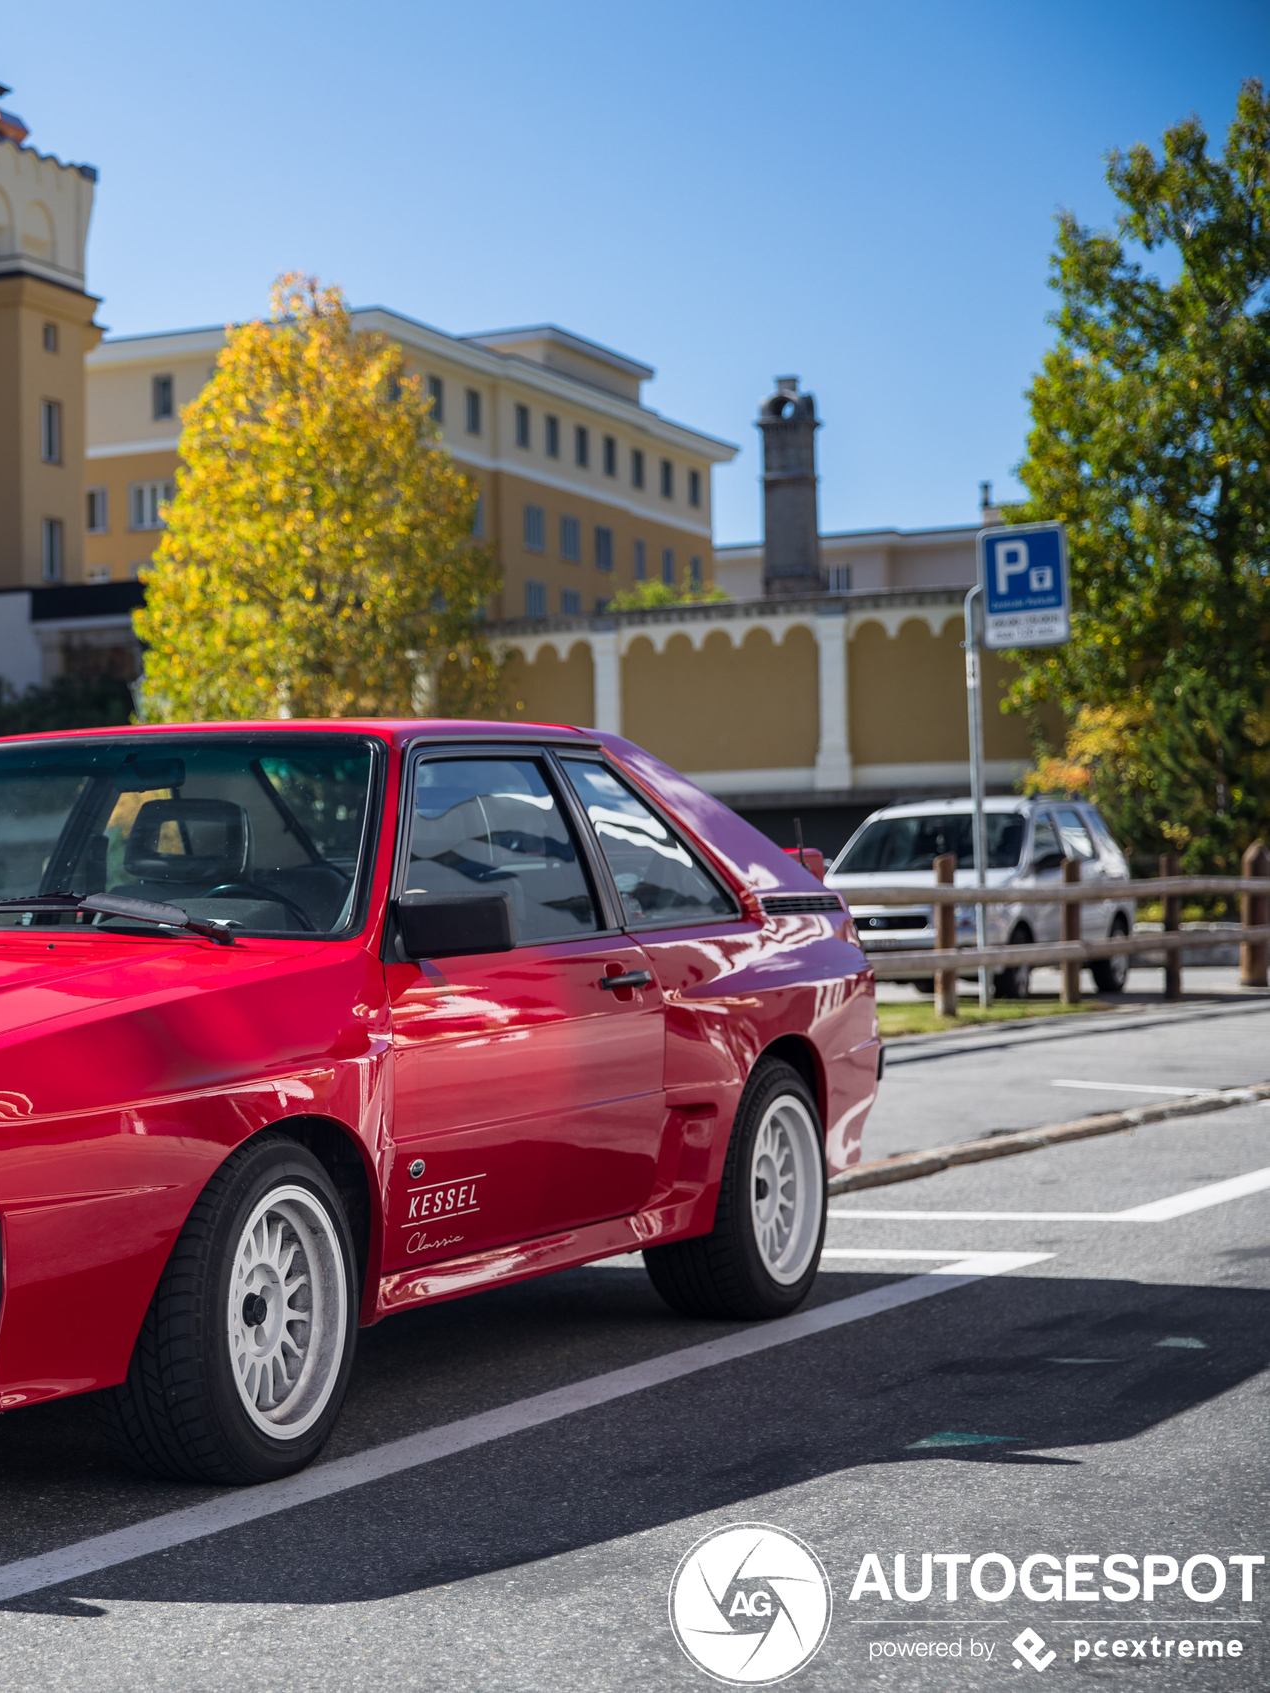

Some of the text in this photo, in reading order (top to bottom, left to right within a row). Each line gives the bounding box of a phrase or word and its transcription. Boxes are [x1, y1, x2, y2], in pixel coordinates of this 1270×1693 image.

[994, 539, 1030, 595] P
[408, 1184, 477, 1219] KESSEL
[406, 1231, 465, 1254] Classic
